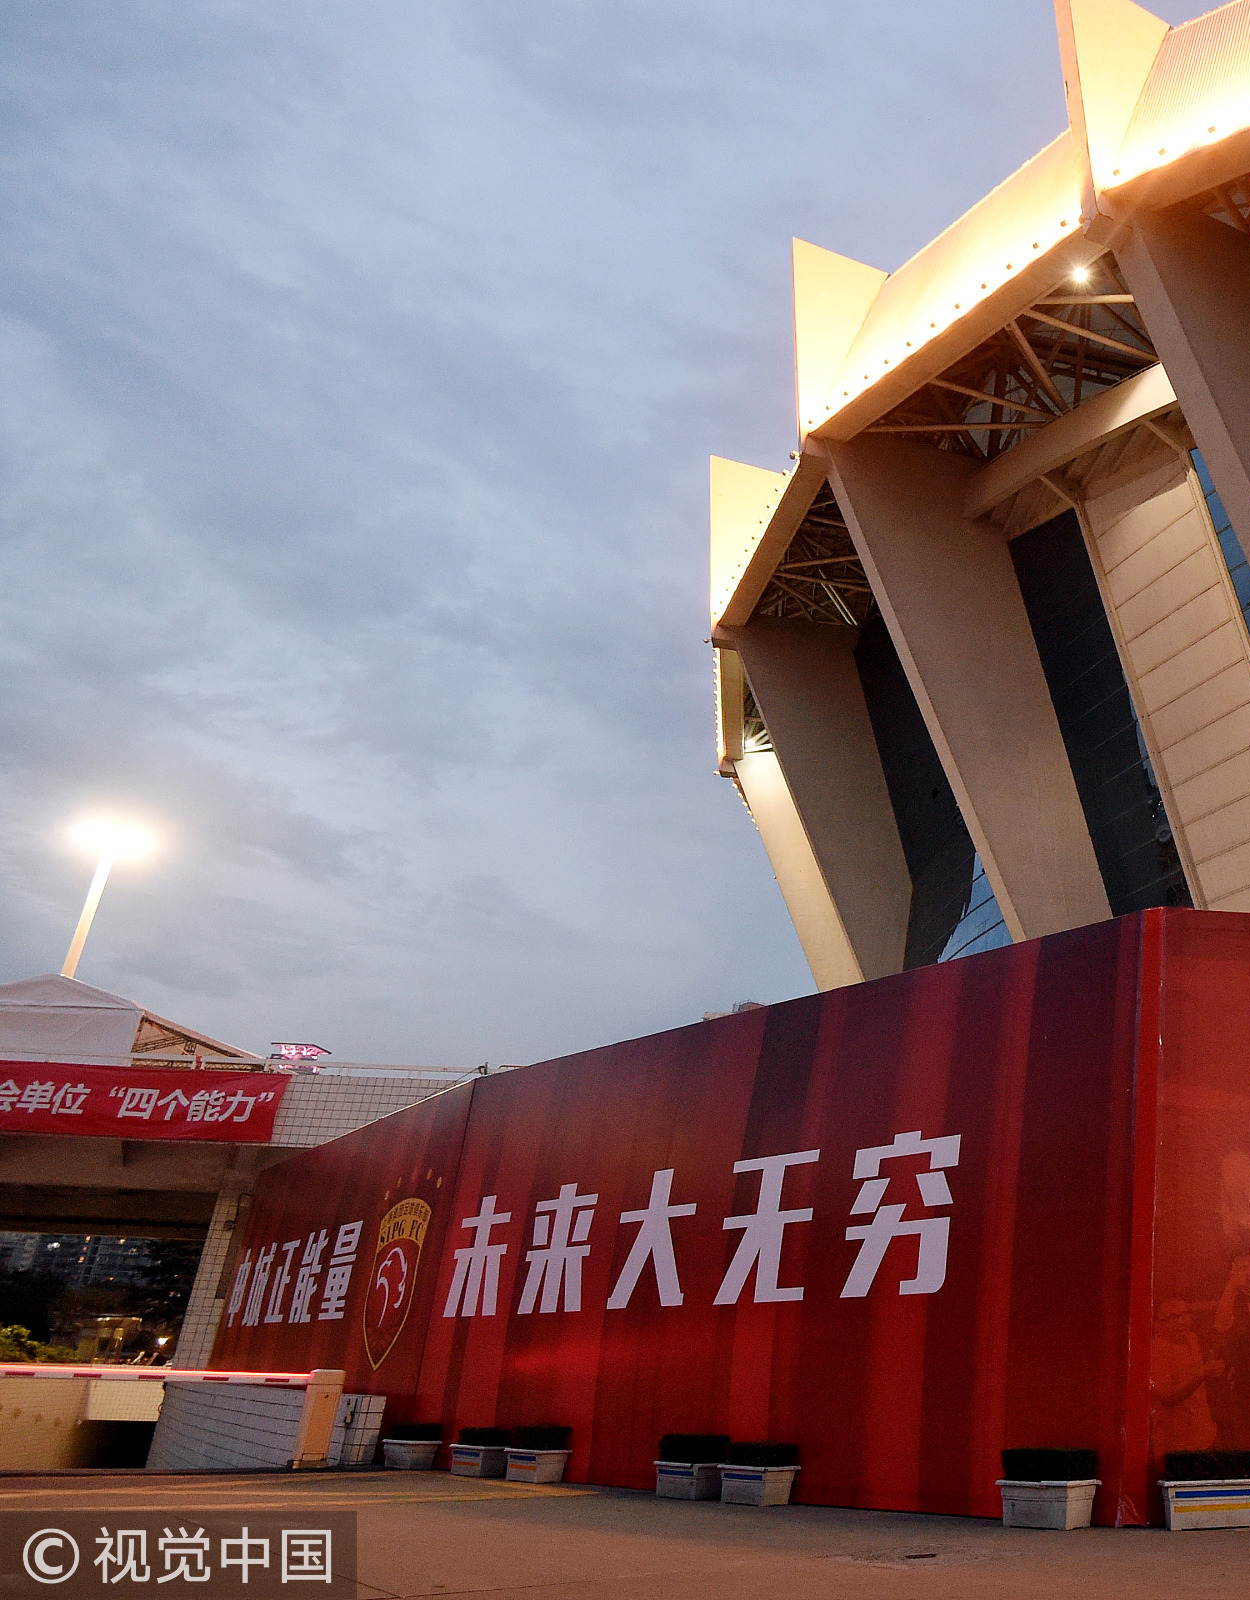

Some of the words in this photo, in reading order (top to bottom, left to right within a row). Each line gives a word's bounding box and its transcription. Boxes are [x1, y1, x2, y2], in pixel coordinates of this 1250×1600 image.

[227, 1220, 363, 1328] 申城正能量
[443, 1130, 962, 1318] 未来大无穷
